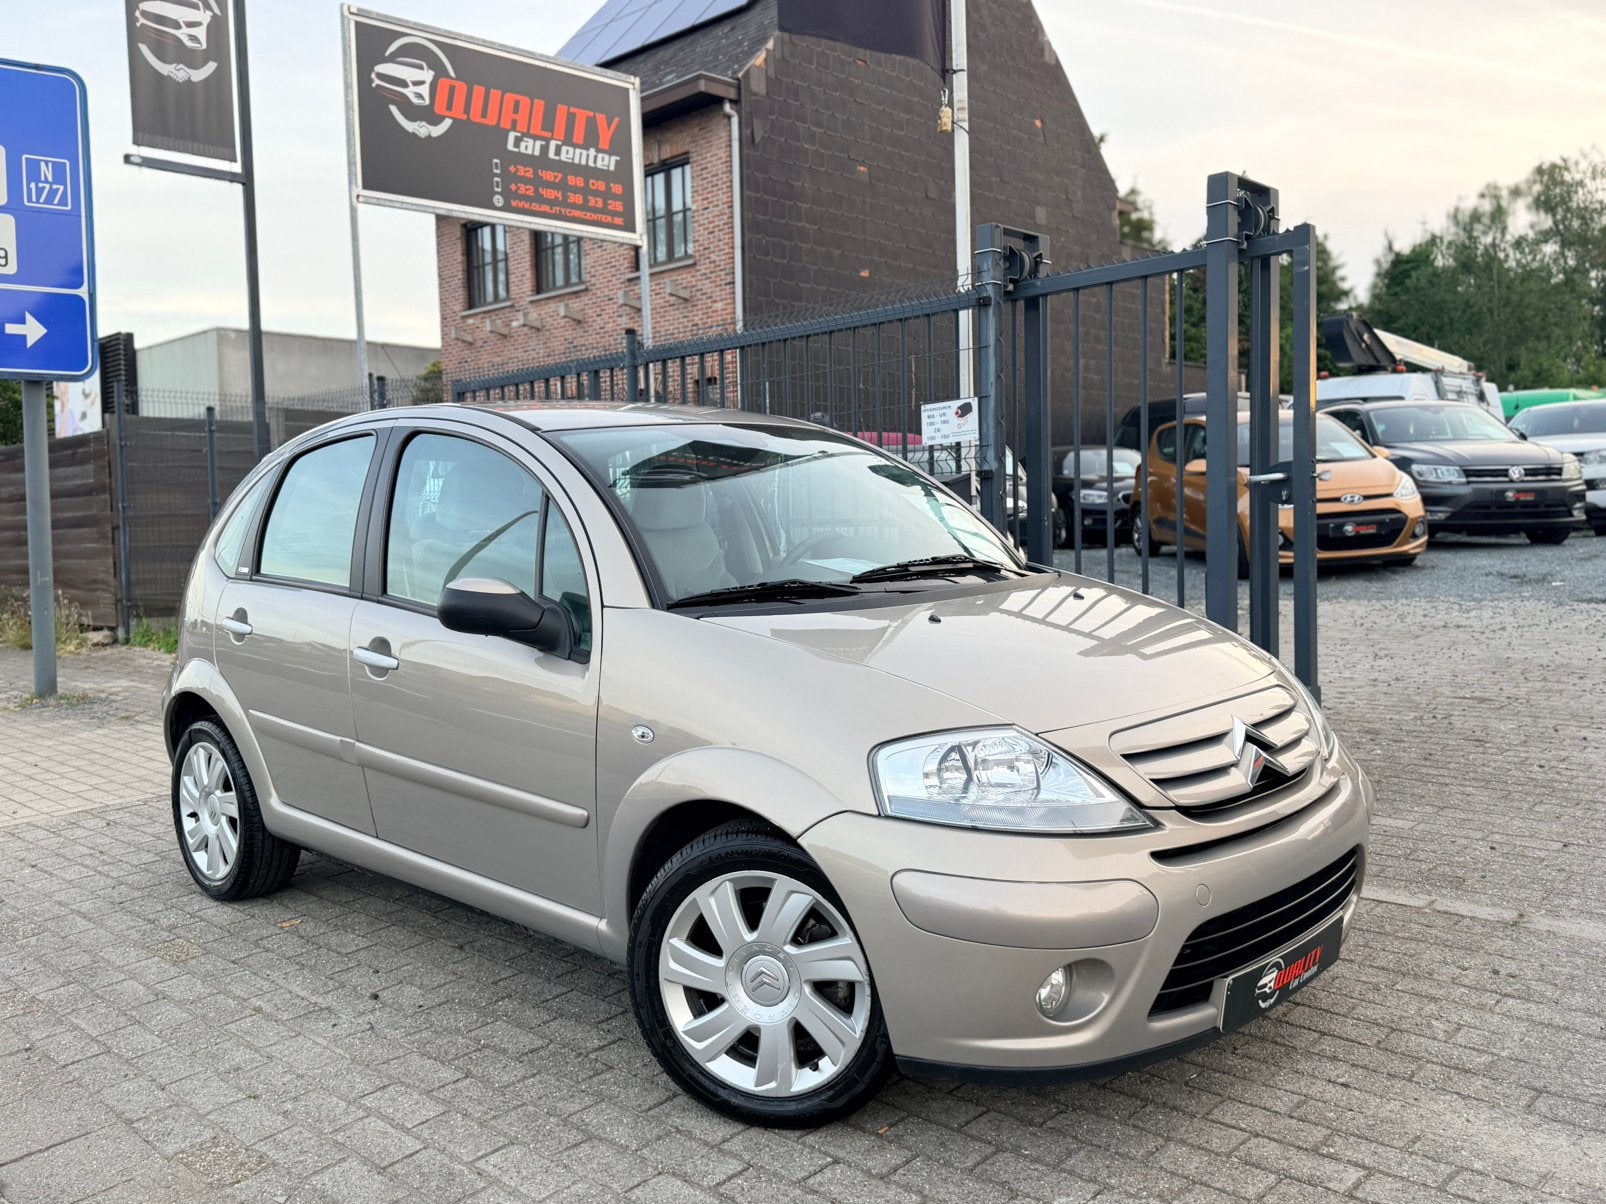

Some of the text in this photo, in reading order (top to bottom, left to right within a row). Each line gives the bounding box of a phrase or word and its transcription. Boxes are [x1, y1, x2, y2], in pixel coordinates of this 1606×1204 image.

[434, 77, 620, 150] QUALITY
[507, 131, 620, 171] Car Center
[40, 161, 53, 182] N
[509, 165, 534, 178] +32
[538, 169, 563, 182] 487
[29, 182, 64, 204] 177
[510, 183, 535, 196] +32
[539, 187, 562, 200] 484
[588, 196, 603, 208] 33
[608, 200, 624, 212] 25
[1274, 944, 1324, 991] QUALITY
